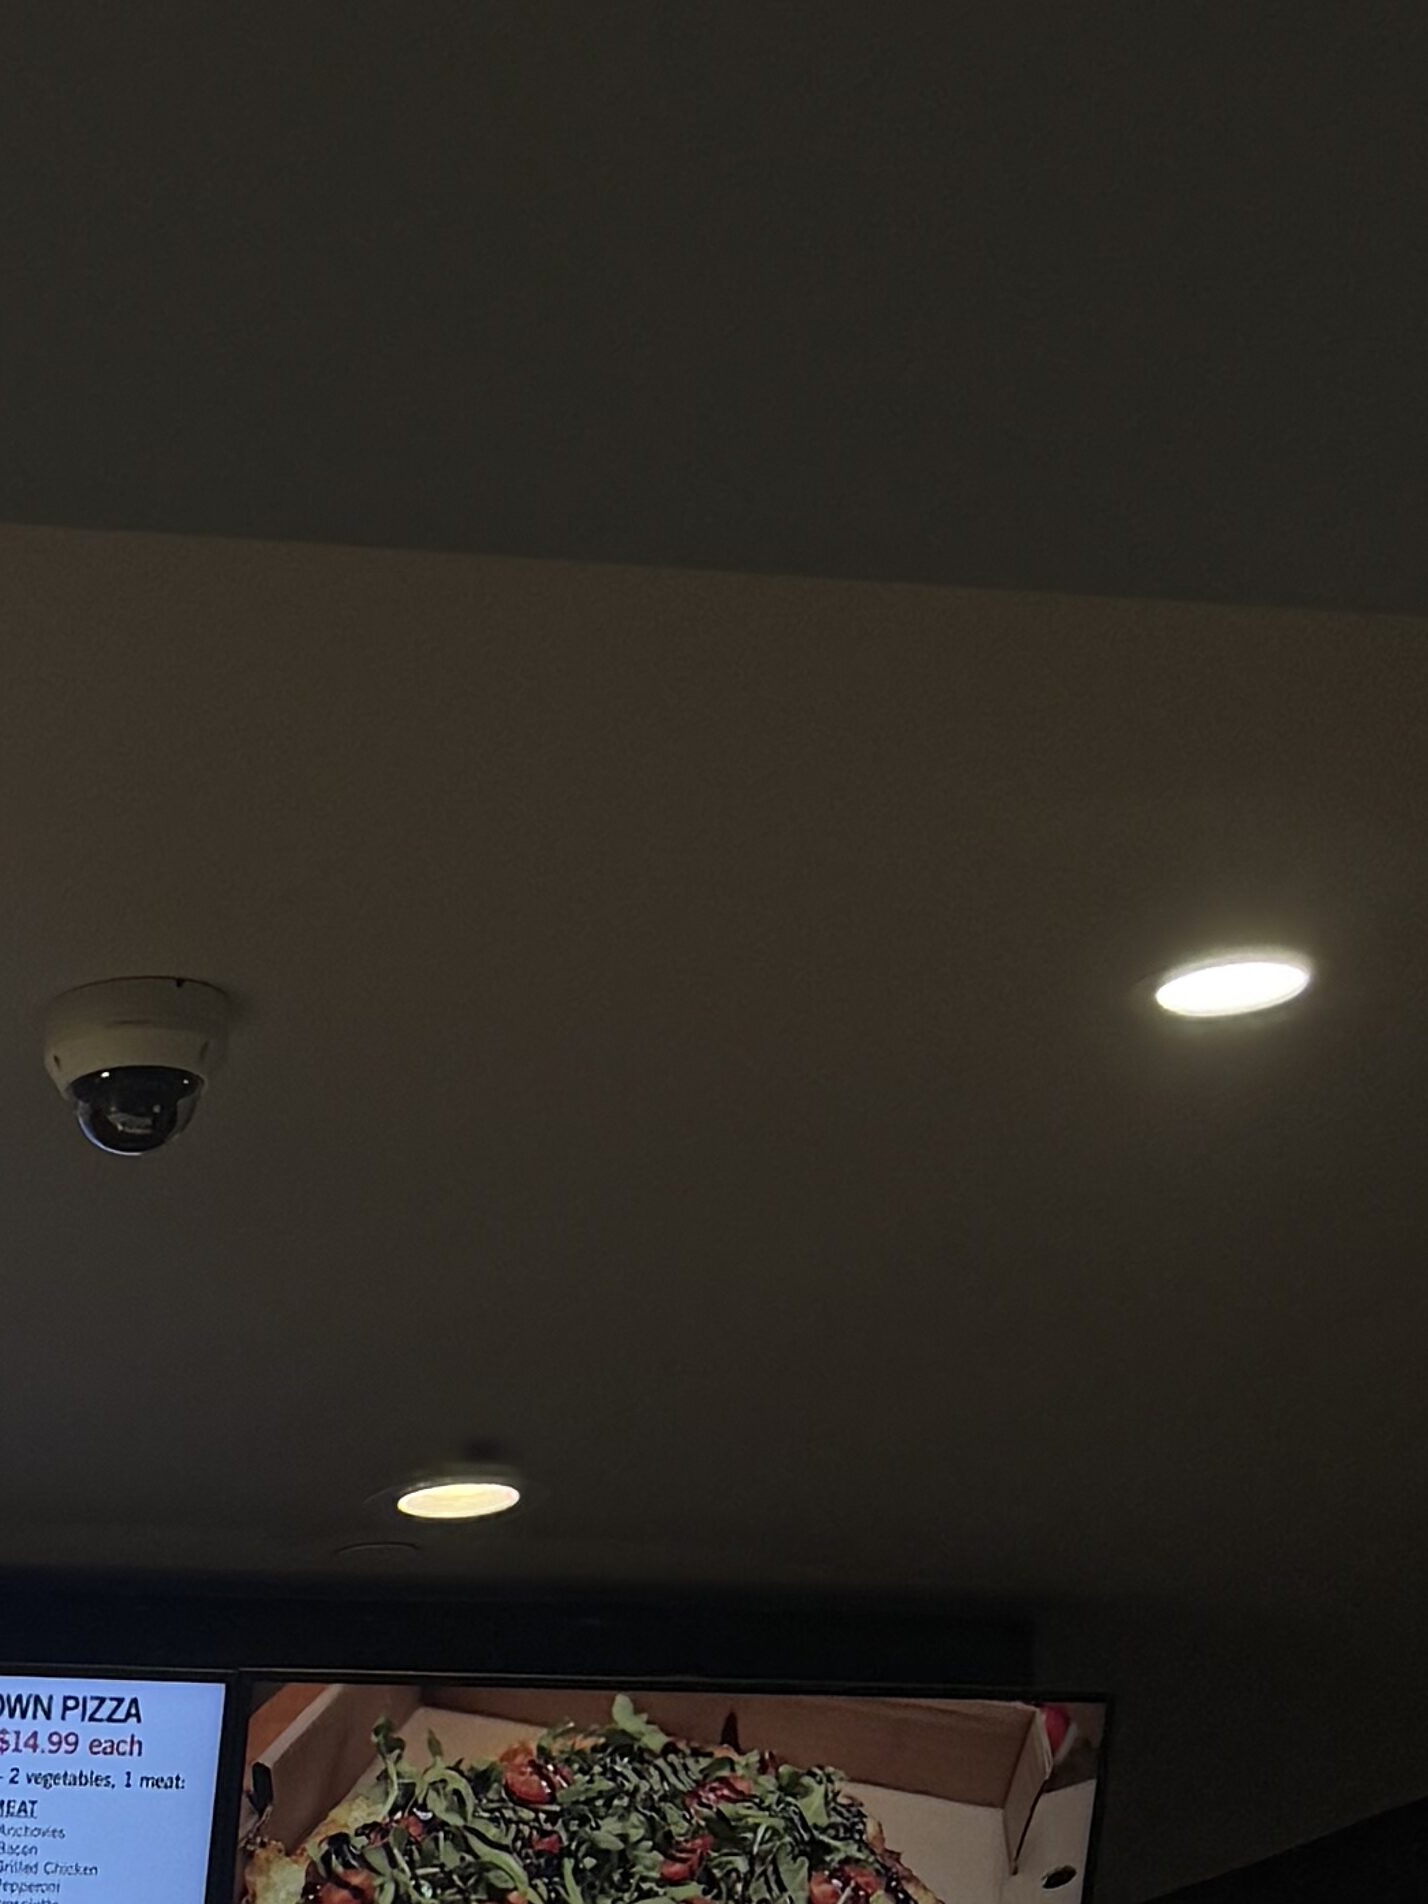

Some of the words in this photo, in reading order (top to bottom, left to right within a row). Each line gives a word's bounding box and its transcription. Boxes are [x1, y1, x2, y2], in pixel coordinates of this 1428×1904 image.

[60, 1695, 142, 1724] PIZZA
[88, 1733, 142, 1757] each
[8, 1766, 20, 1785] 2
[25, 1770, 116, 1790] vegetables,
[124, 1770, 132, 1789] 1
[139, 1773, 185, 1790] meat:
